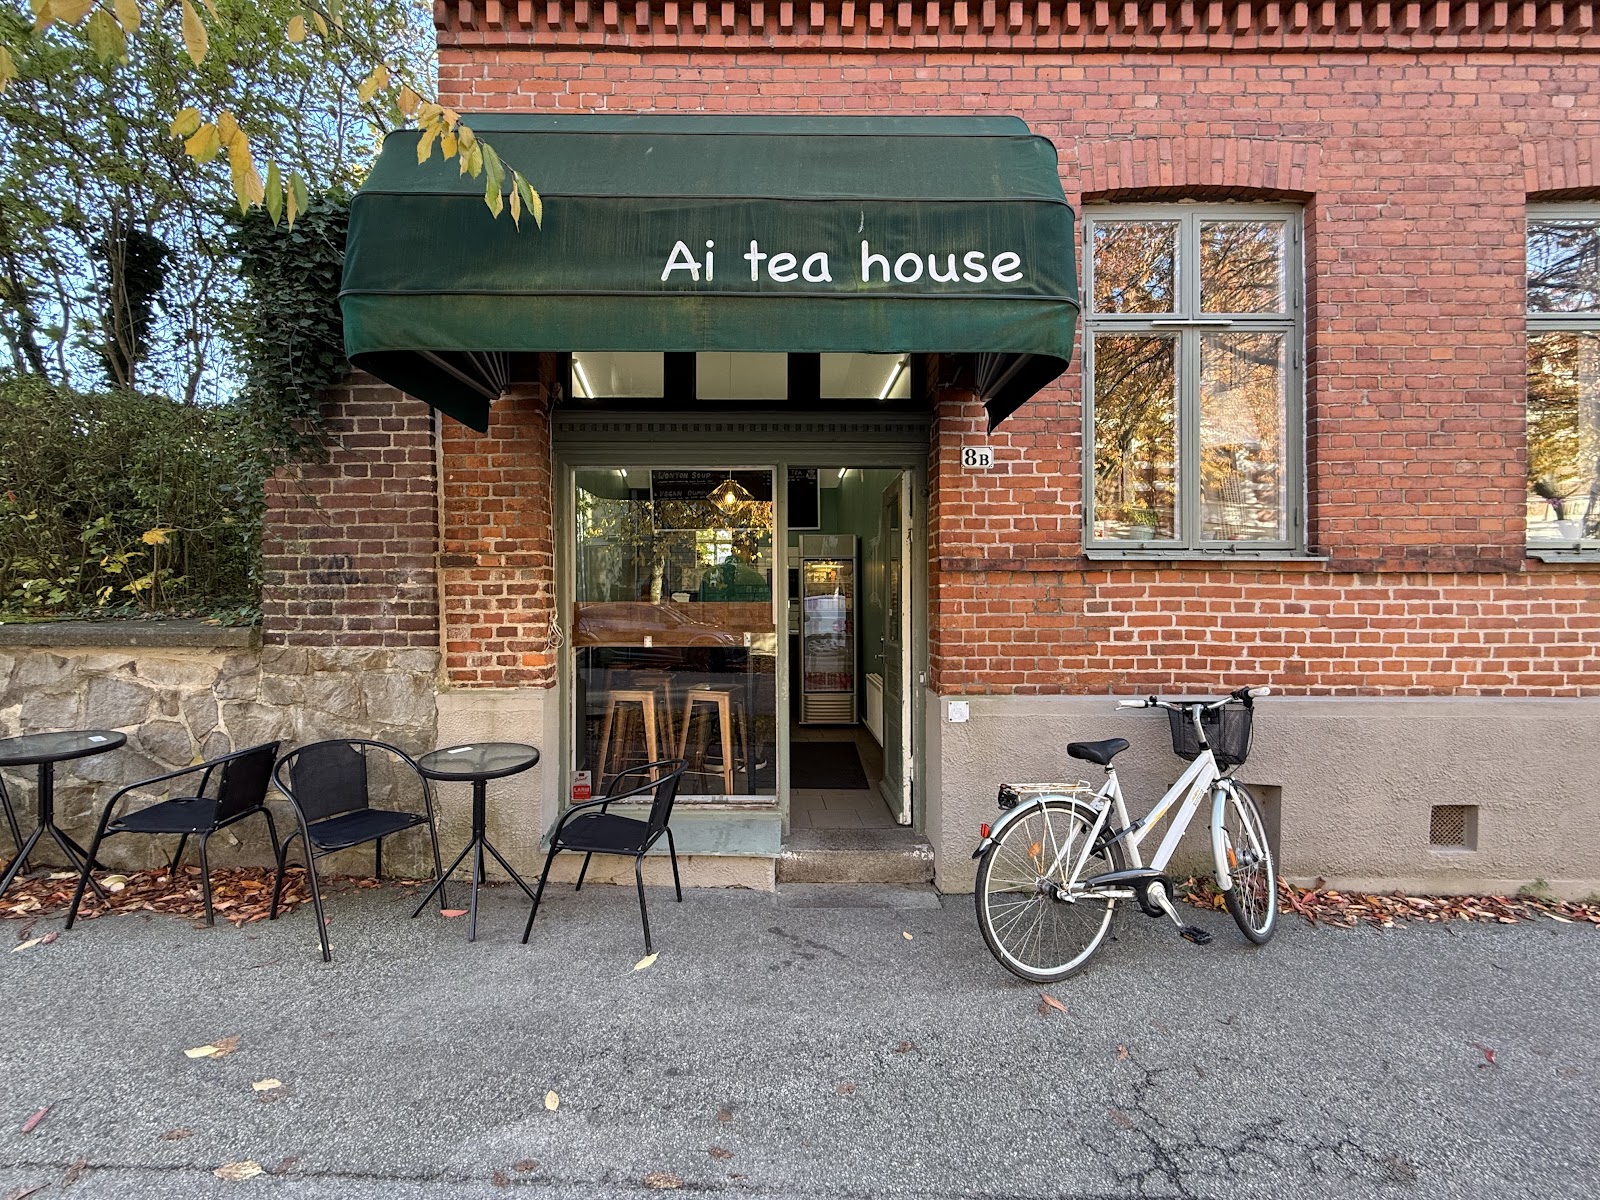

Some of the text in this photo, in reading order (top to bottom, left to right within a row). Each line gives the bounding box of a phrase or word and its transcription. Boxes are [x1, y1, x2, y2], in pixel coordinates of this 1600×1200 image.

[660, 239, 1024, 283] Ai tea house
